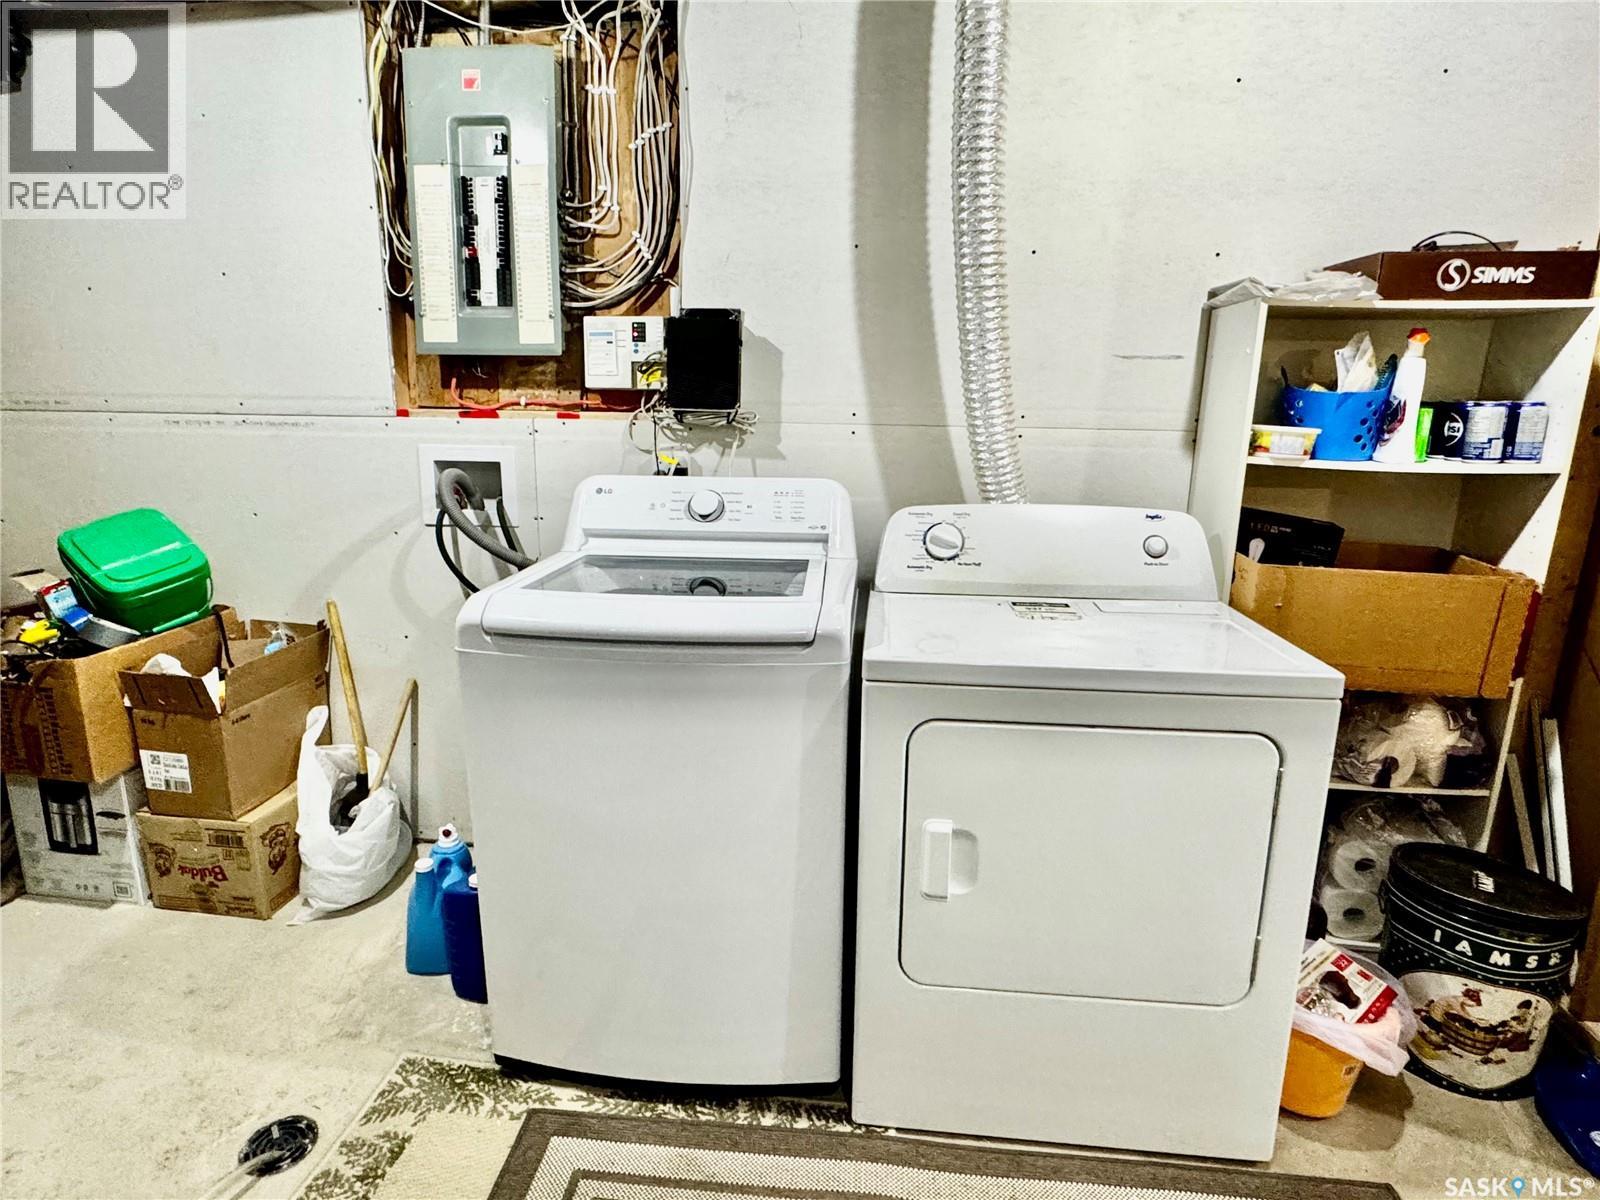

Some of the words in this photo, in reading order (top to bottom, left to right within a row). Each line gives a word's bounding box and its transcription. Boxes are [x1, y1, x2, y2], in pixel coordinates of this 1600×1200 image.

[1471, 266, 1537, 284] SIMMS
[177, 864, 229, 882] Buldak
[1433, 929, 1539, 969] IAMS
